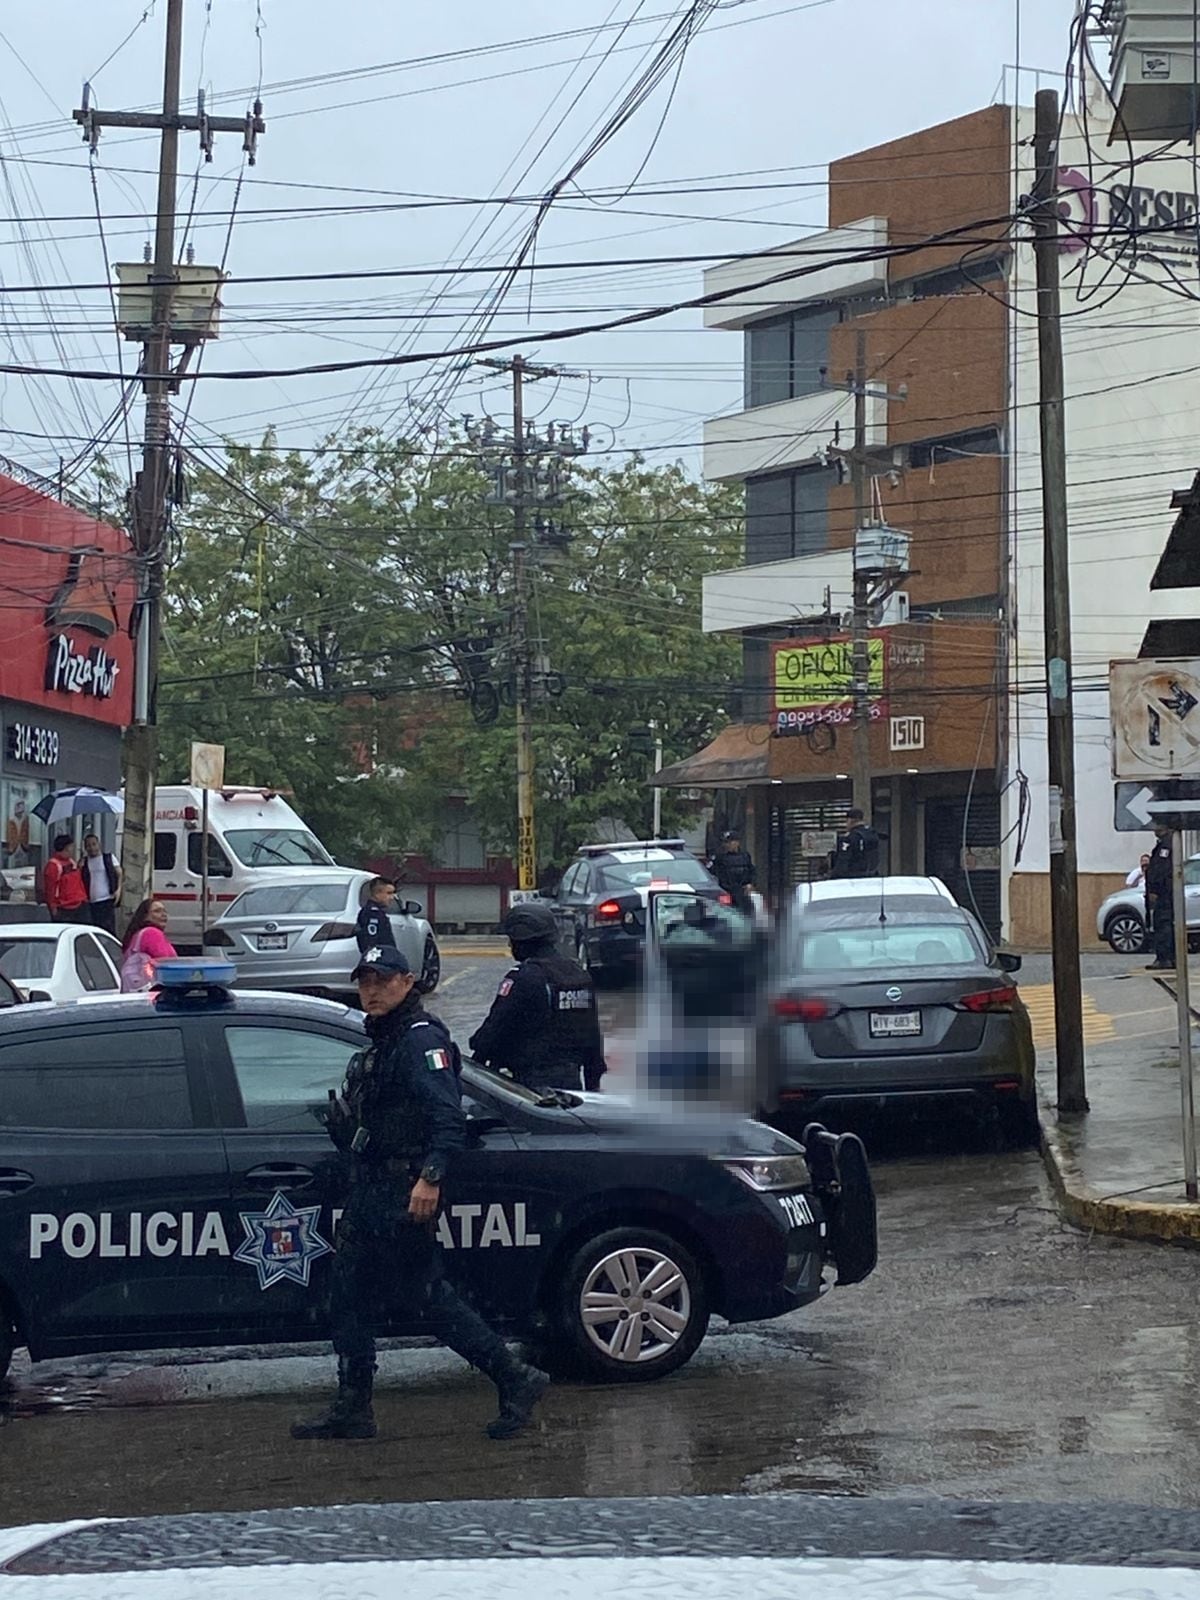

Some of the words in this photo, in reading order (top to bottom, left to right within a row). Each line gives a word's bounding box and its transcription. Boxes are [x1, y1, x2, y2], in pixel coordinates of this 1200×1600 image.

[53, 633, 93, 694] Pizza
[92, 647, 120, 697] Hut
[15, 723, 59, 765] 314-3839
[29, 1211, 231, 1259] POLICIA
